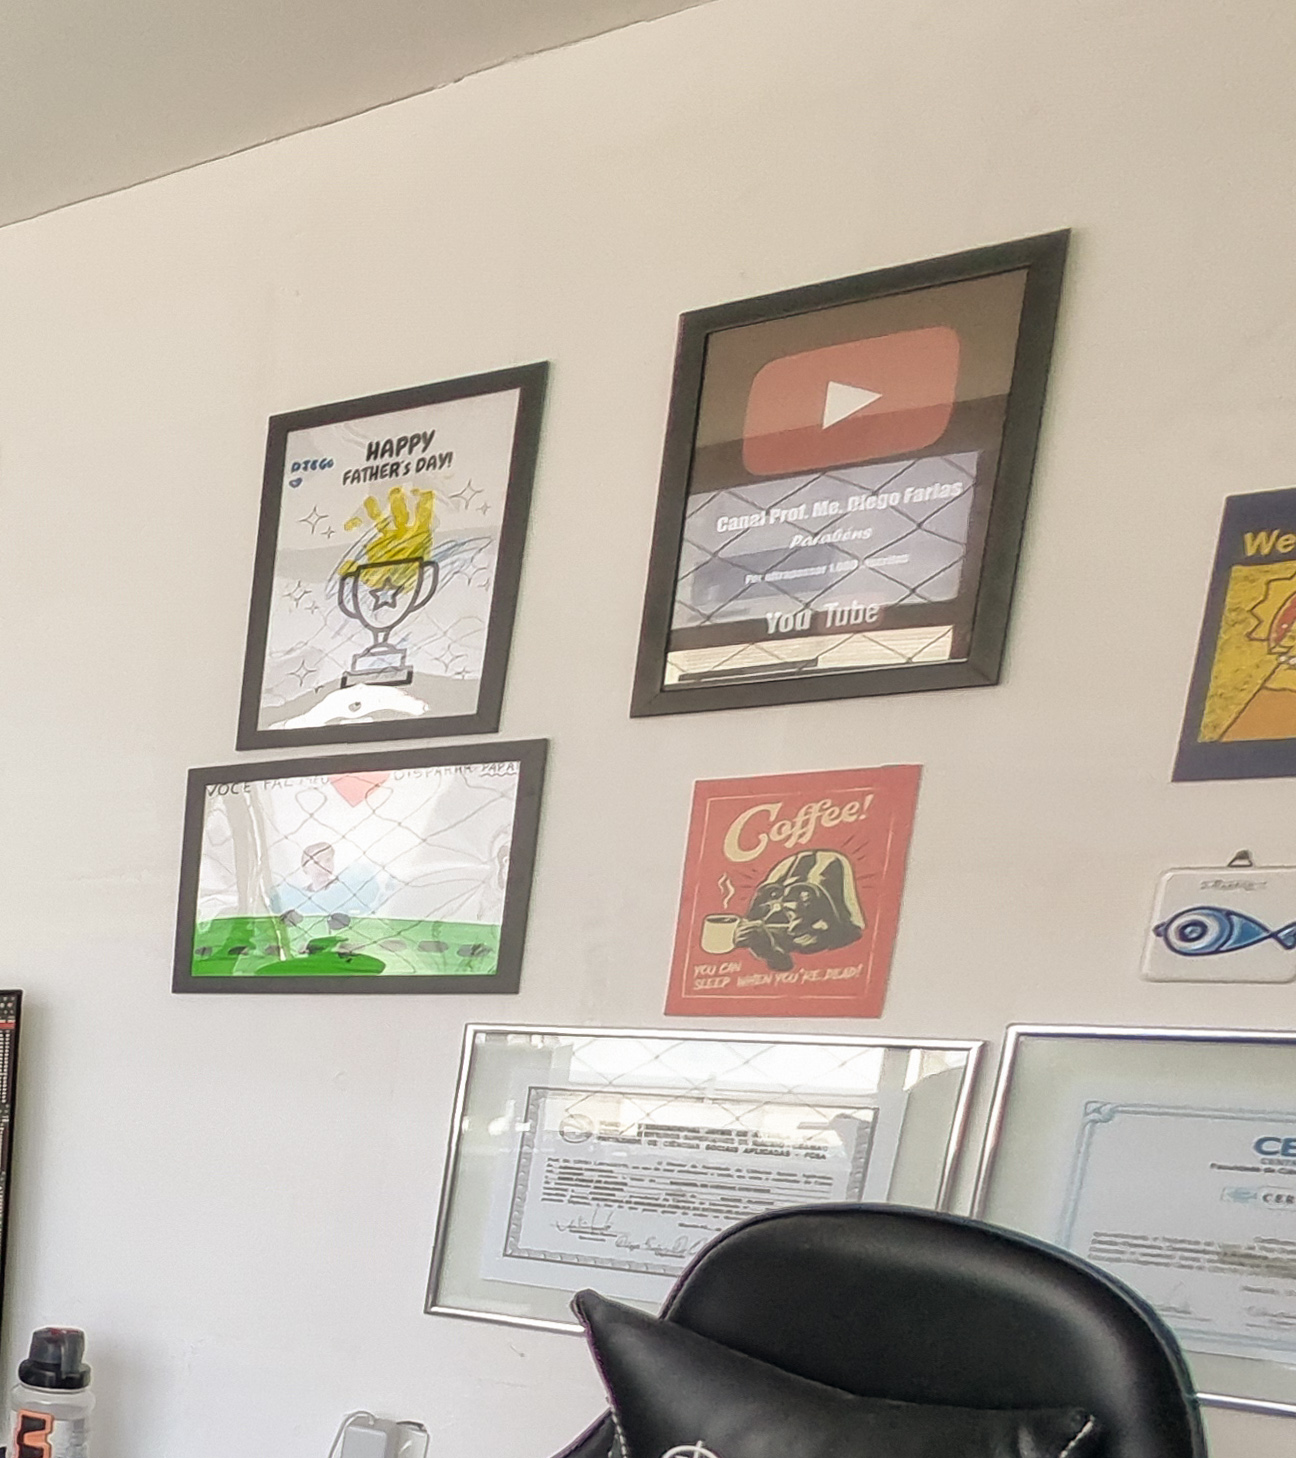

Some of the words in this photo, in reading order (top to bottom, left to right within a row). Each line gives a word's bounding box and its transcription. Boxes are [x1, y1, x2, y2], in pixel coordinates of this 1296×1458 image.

[365, 429, 436, 462] HAPPY
[342, 461, 411, 486] FATHER'S
[415, 451, 454, 470] DAY!
[812, 499, 844, 518] Me.
[848, 490, 901, 513] Diego
[903, 481, 964, 505] Farias
[766, 608, 812, 635] You
[824, 600, 881, 629] Tube
[723, 794, 875, 862] Coffee!
